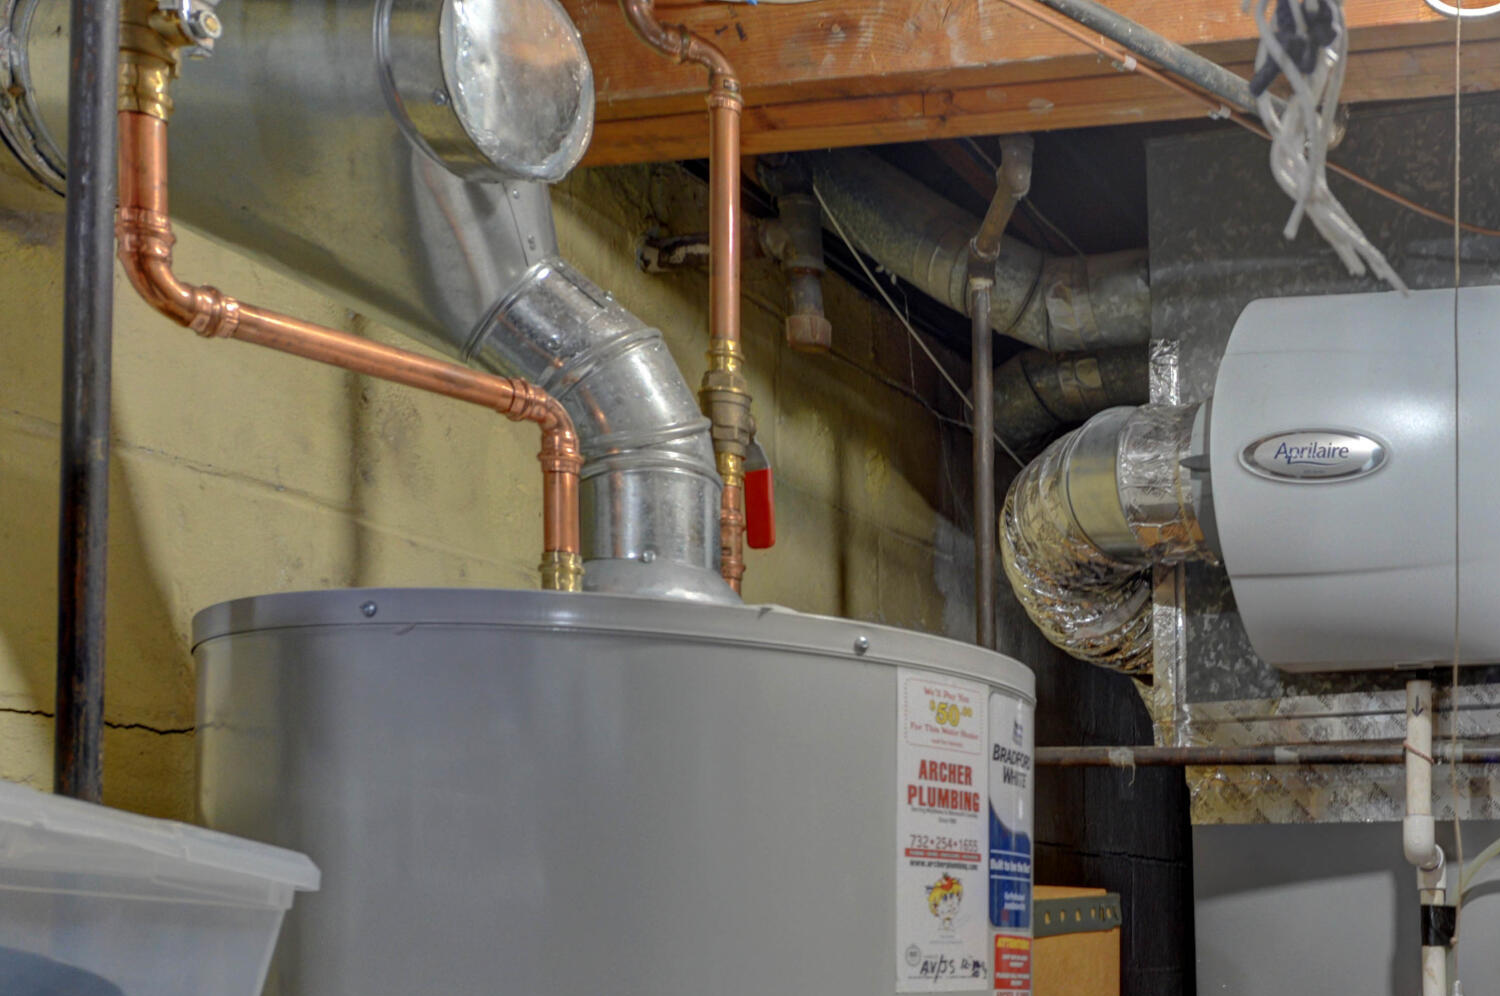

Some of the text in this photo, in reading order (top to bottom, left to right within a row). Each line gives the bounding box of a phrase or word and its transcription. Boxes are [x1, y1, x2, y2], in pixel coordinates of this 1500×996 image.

[1274, 442, 1349, 464] Aprilaire
[918, 759, 972, 786] ARCHER
[1002, 765, 1027, 789] WHITE
[907, 784, 980, 813] PLUMBING
